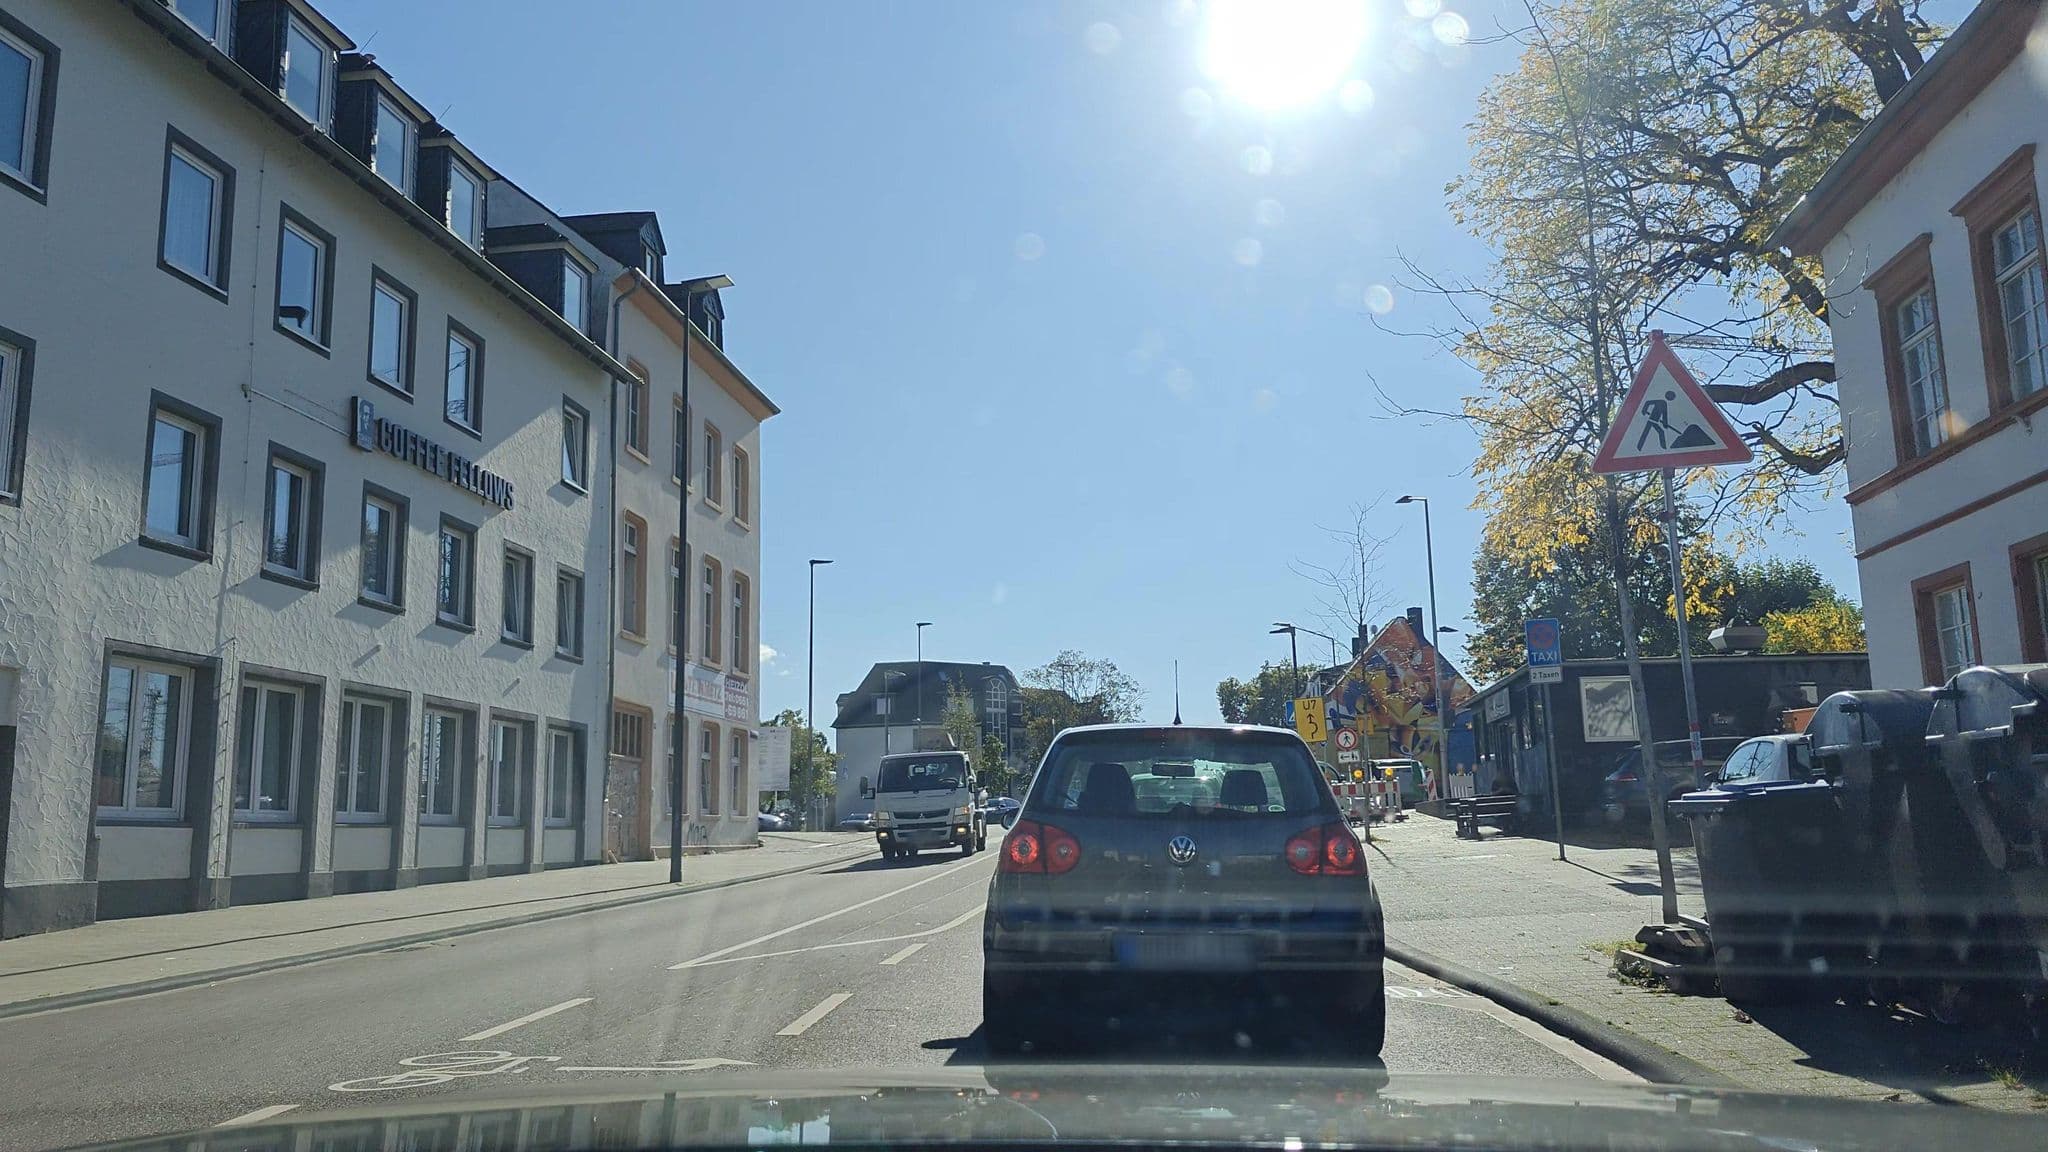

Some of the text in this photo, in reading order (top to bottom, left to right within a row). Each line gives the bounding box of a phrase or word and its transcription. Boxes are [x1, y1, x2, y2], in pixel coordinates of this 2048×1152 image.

[378, 417, 516, 510] COFFEE FELLOWS
[1531, 651, 1558, 662] TAXI
[1302, 699, 1316, 710] U7
